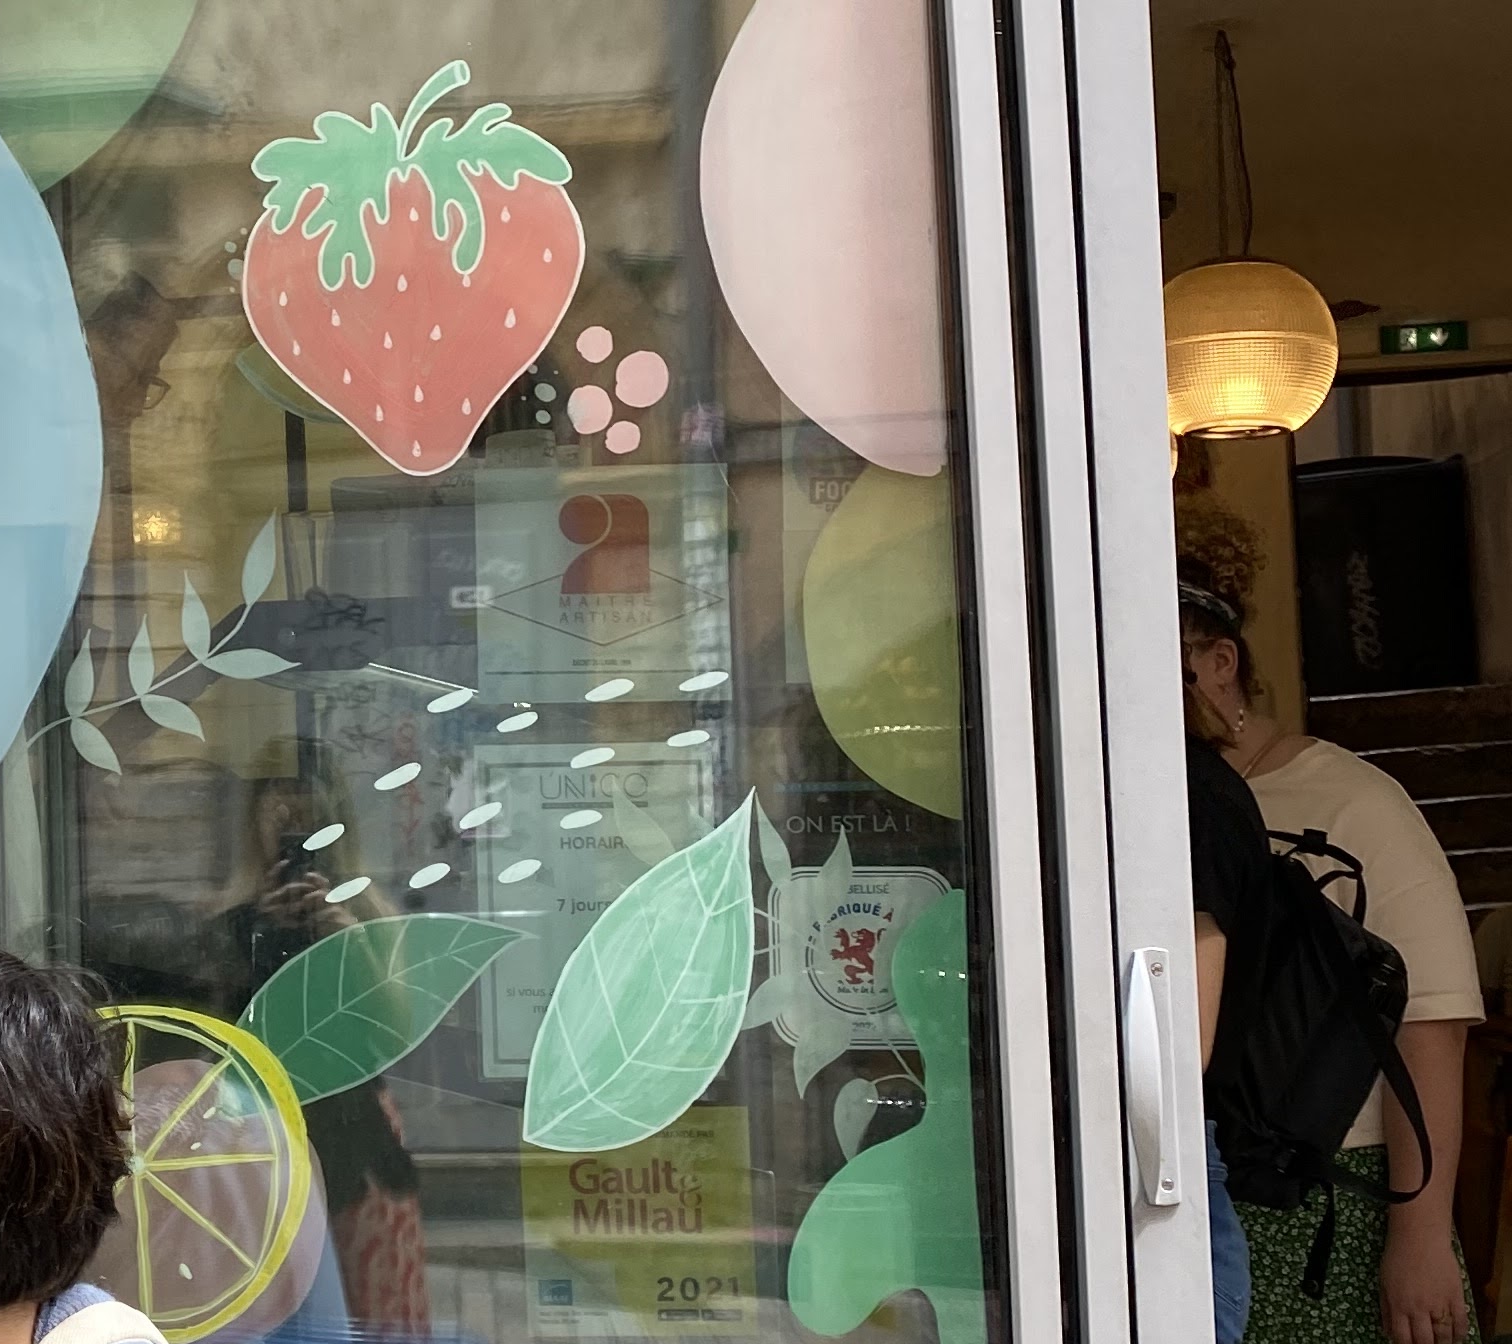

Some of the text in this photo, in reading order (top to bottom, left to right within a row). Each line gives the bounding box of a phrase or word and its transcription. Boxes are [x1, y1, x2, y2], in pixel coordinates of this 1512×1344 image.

[786, 815, 823, 835] ON
[831, 813, 866, 834] EST
[872, 808, 898, 834] LÀ
[559, 836, 626, 850] HORAIR
[557, 898, 566, 912] 7
[572, 1199, 703, 1235] Millau
[656, 1275, 740, 1303] 2021
